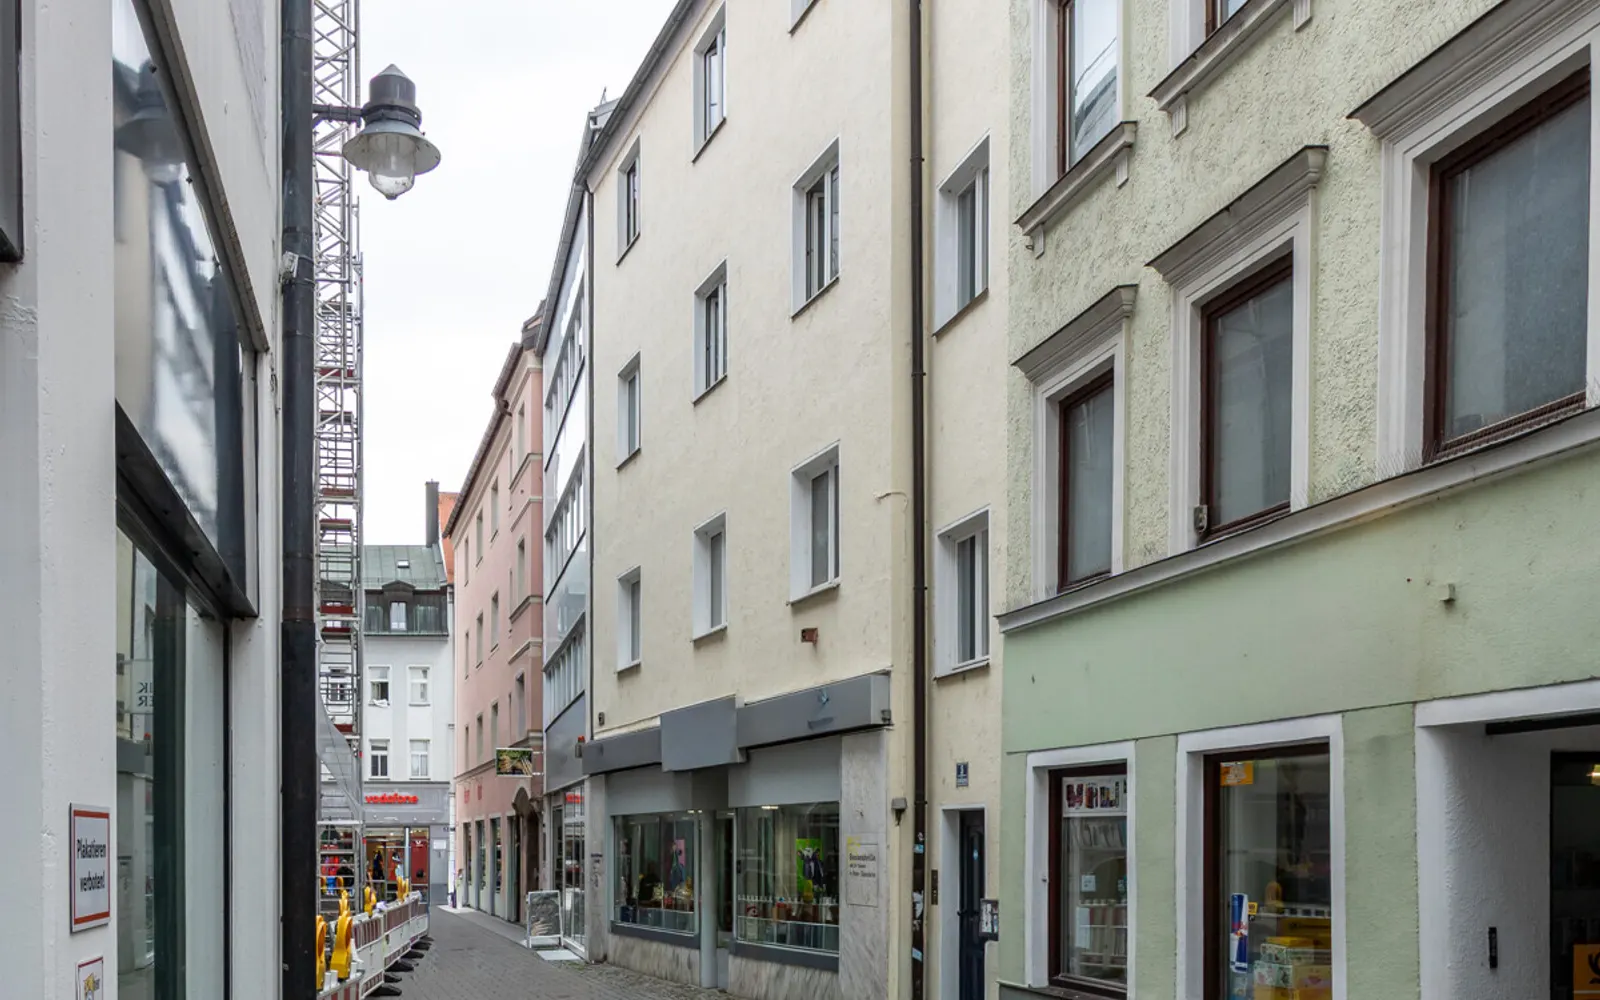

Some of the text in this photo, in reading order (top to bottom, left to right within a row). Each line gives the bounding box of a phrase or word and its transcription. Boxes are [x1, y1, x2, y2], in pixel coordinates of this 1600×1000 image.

[365, 792, 418, 804] vodafone
[77, 838, 106, 859] Plakatieren
[80, 869, 105, 892] verboten!
